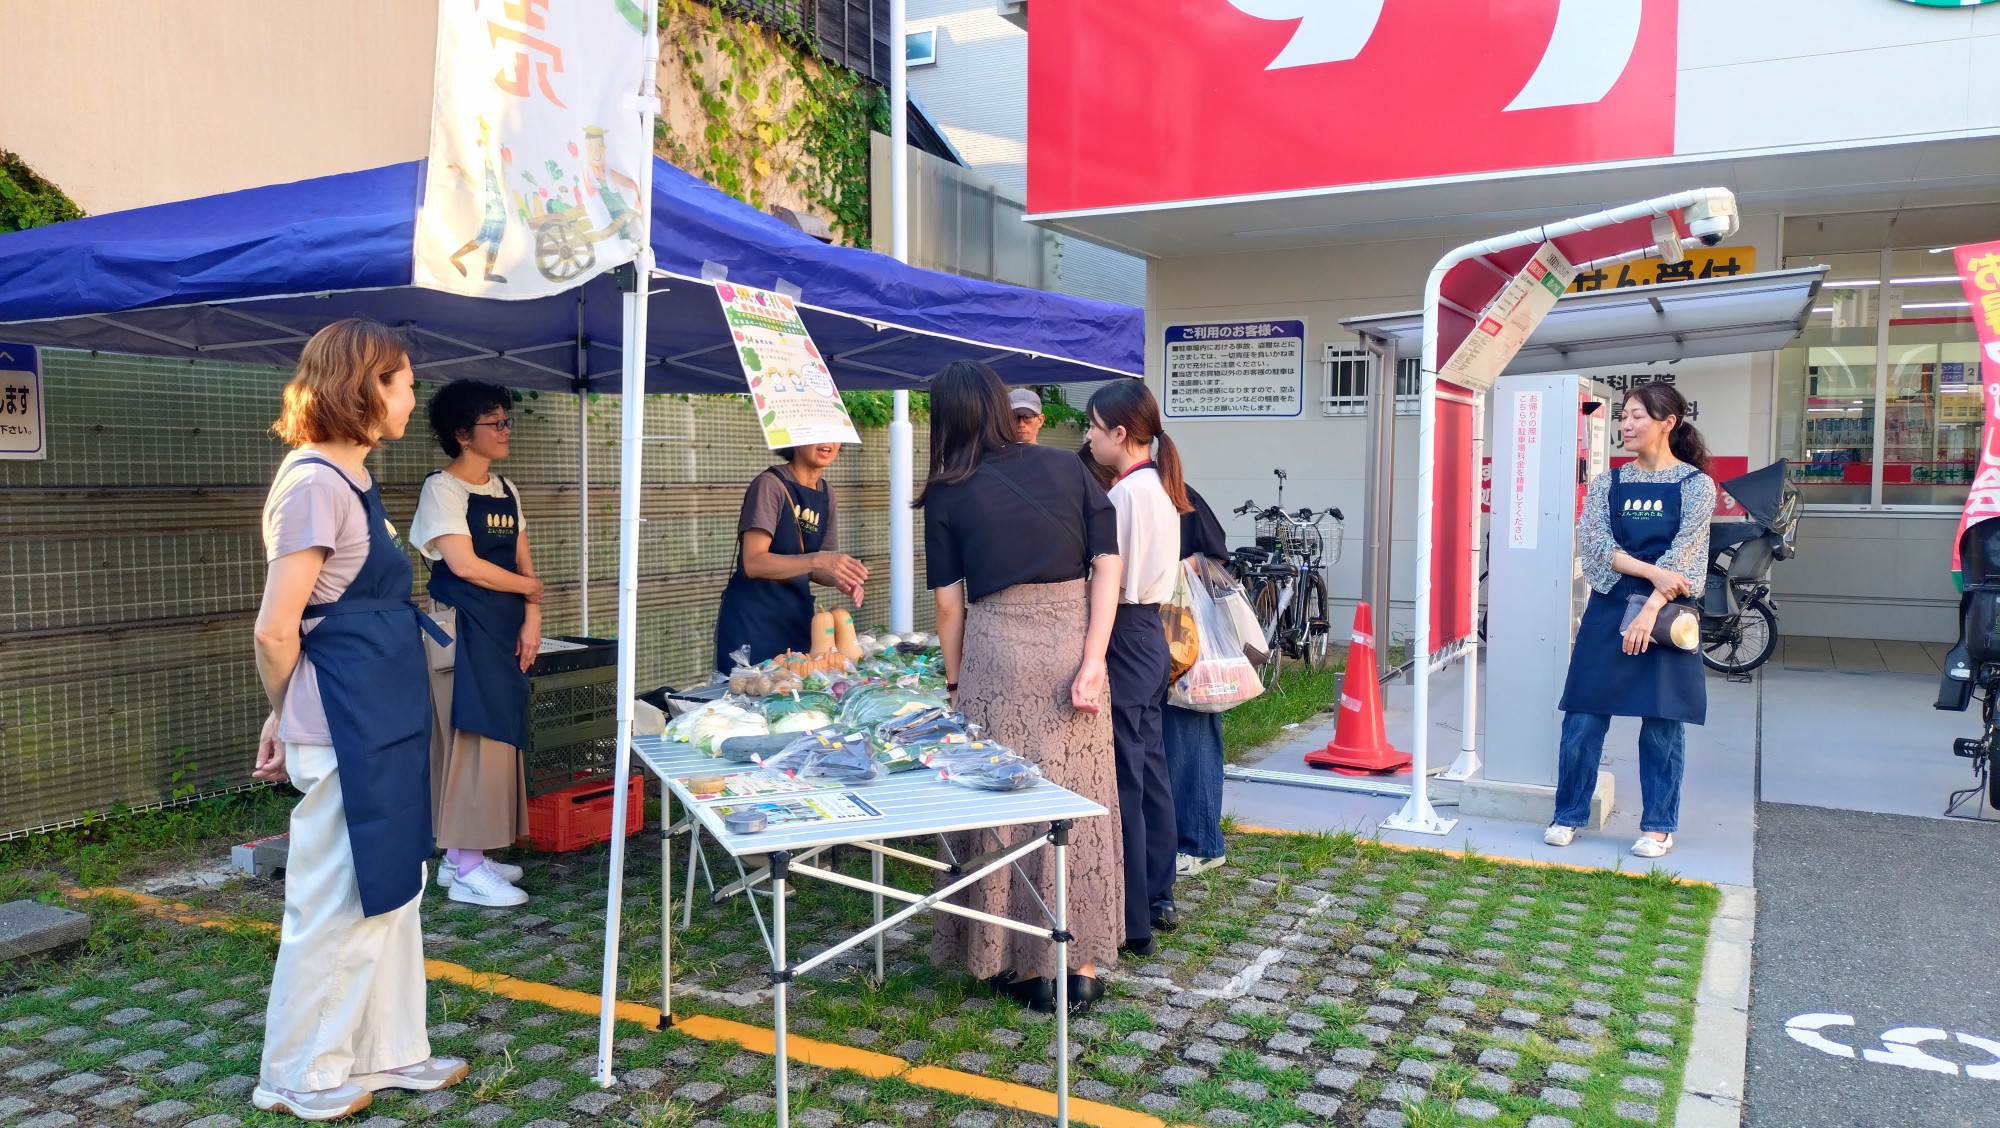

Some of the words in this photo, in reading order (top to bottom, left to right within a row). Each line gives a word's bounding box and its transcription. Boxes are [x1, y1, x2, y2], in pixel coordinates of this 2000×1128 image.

[1182, 324, 1284, 339] ご利用のお客様へ
[0, 384, 30, 416] ます
[1528, 394, 1538, 444] お帰りの際は
[1514, 394, 1528, 546] こちらで駐車場料金を精算してください。
